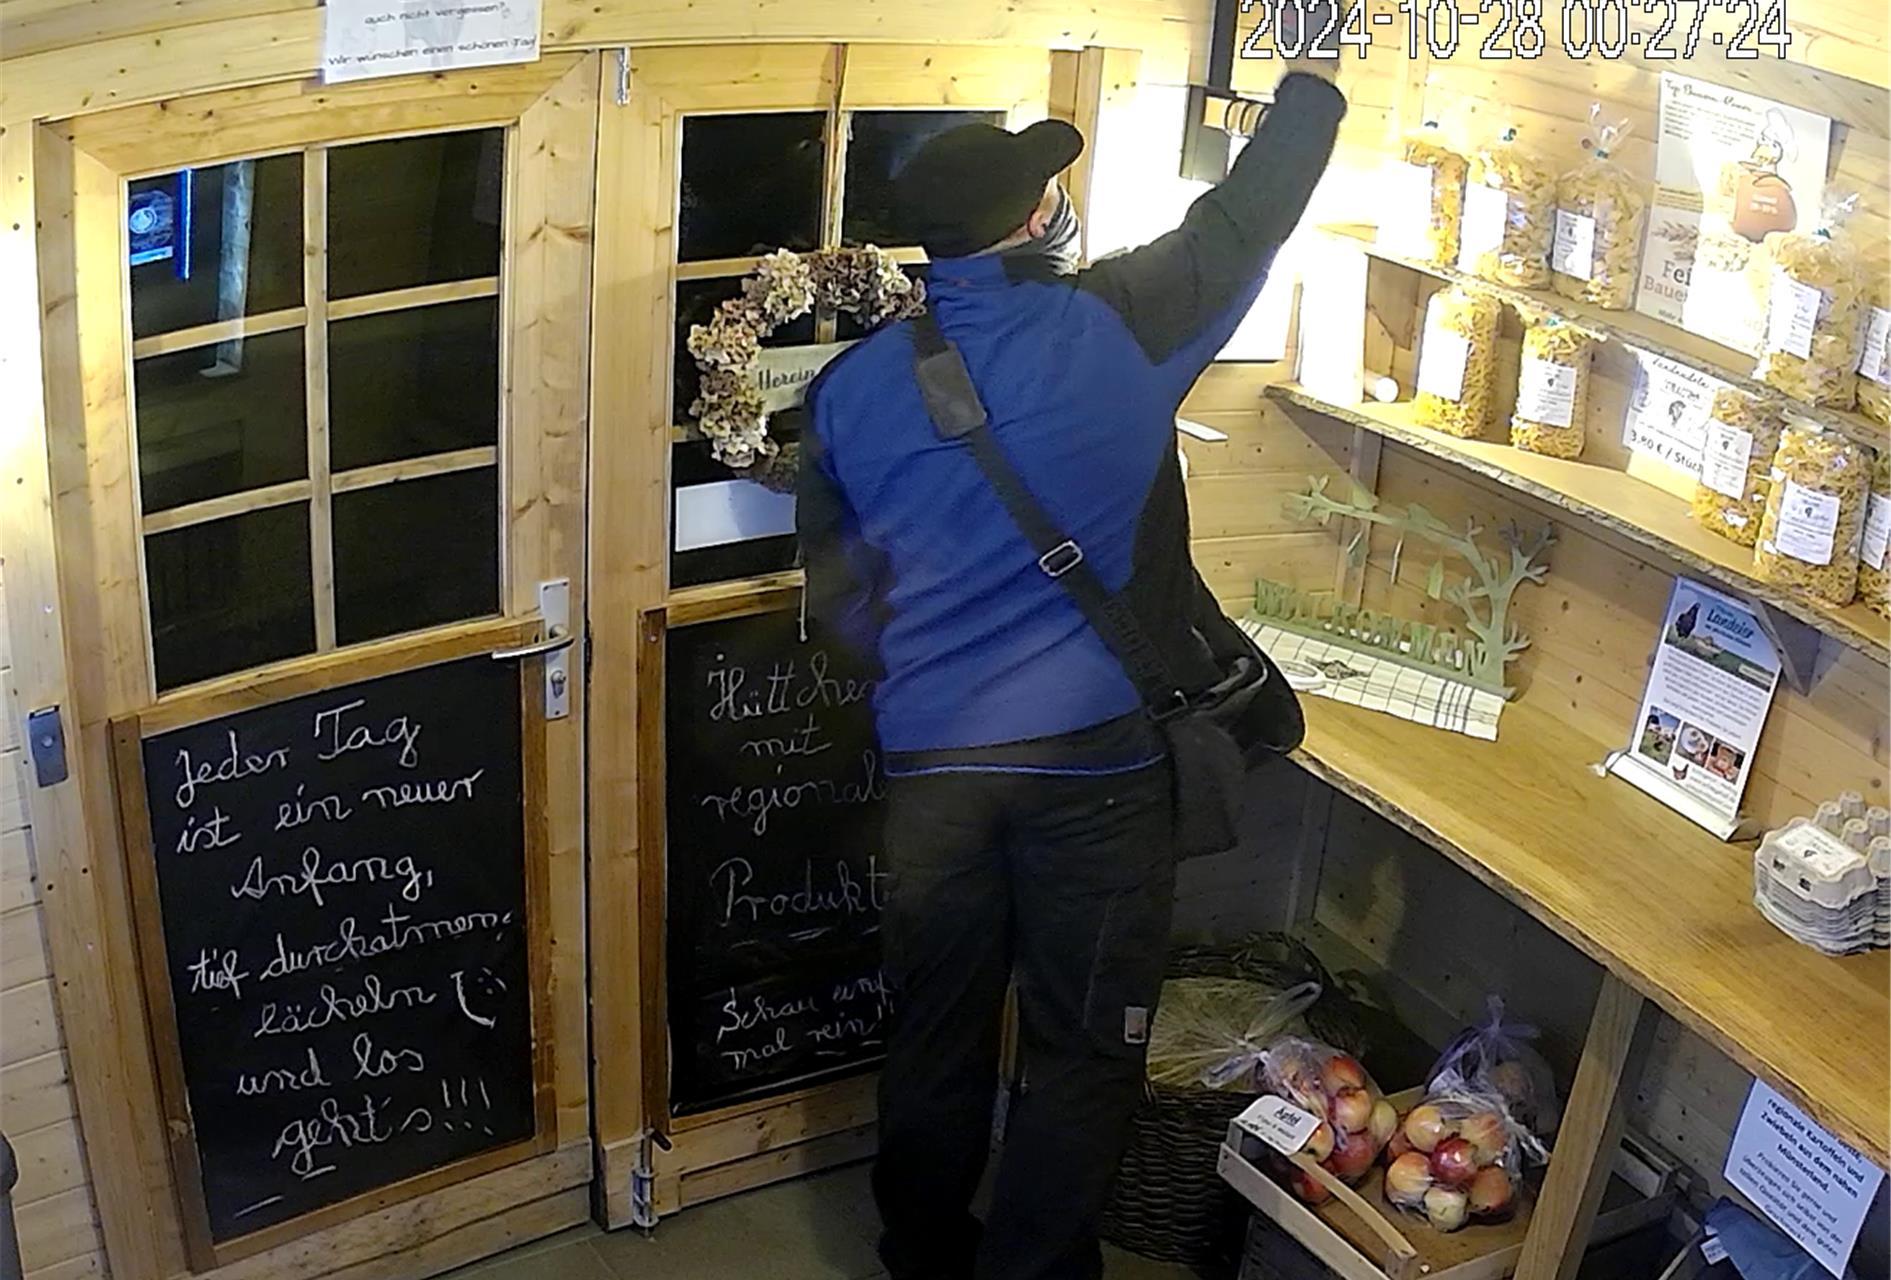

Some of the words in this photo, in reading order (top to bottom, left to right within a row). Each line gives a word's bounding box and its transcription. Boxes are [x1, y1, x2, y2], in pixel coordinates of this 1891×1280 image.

[364, 13, 396, 25] auch
[400, 10, 430, 20] nicht
[328, 54, 352, 66] Wir
[1662, 257, 1694, 287] Fei
[174, 730, 290, 808] Jeder
[313, 699, 421, 768] Tag
[740, 712, 832, 756] mit
[176, 806, 242, 853] ist
[274, 783, 353, 832] ein
[361, 768, 484, 808] neuer
[701, 749, 886, 836] regional
[709, 855, 888, 927] Produkt
[186, 947, 250, 1000] tief
[254, 974, 437, 1038] lächeln
[716, 986, 820, 1045] Schau
[832, 969, 893, 1006] einf
[236, 1046, 332, 1095] und
[353, 1032, 424, 1080] los
[720, 1027, 794, 1070] mal
[1761, 1111, 1798, 1145] Zwiebeln
[1798, 1143, 1813, 1159] aus
[1813, 1156, 1832, 1175] dem
[1833, 1173, 1859, 1199] nahen
[1767, 1098, 1805, 1132] regionale
[1805, 1129, 1847, 1169] Kartoffeln
[1847, 1166, 1865, 1184] und
[1777, 1143, 1830, 1194] Münsterland.
[1757, 1152, 1791, 1183] Probieren
[1822, 1208, 1838, 1223] und
